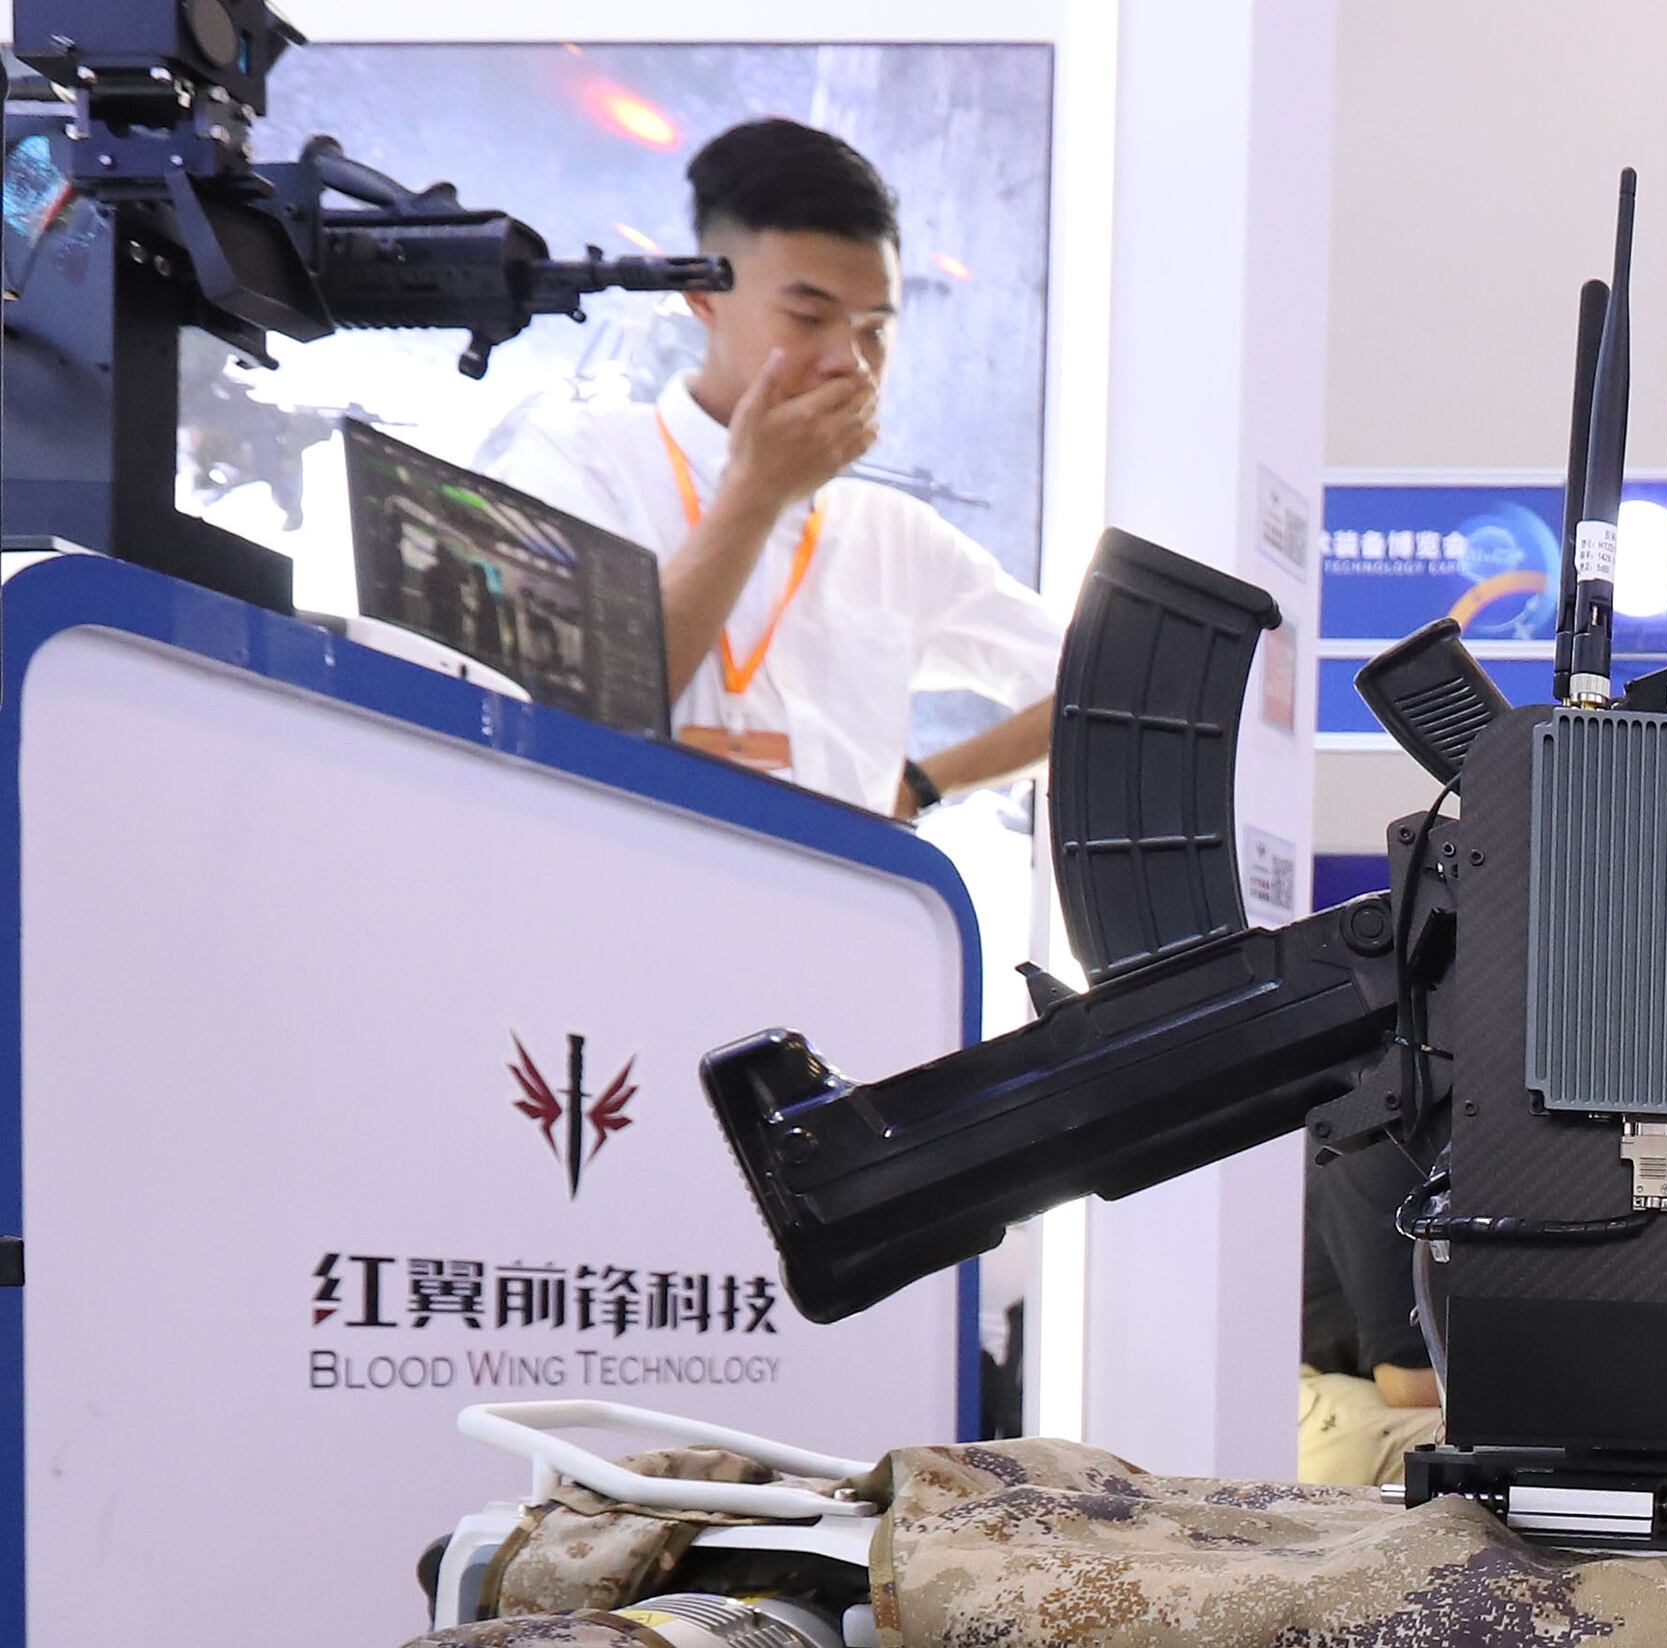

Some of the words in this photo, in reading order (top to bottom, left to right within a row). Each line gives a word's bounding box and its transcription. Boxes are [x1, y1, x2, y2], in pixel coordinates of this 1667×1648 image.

[313, 1253, 779, 1338] 红翼前锋科技
